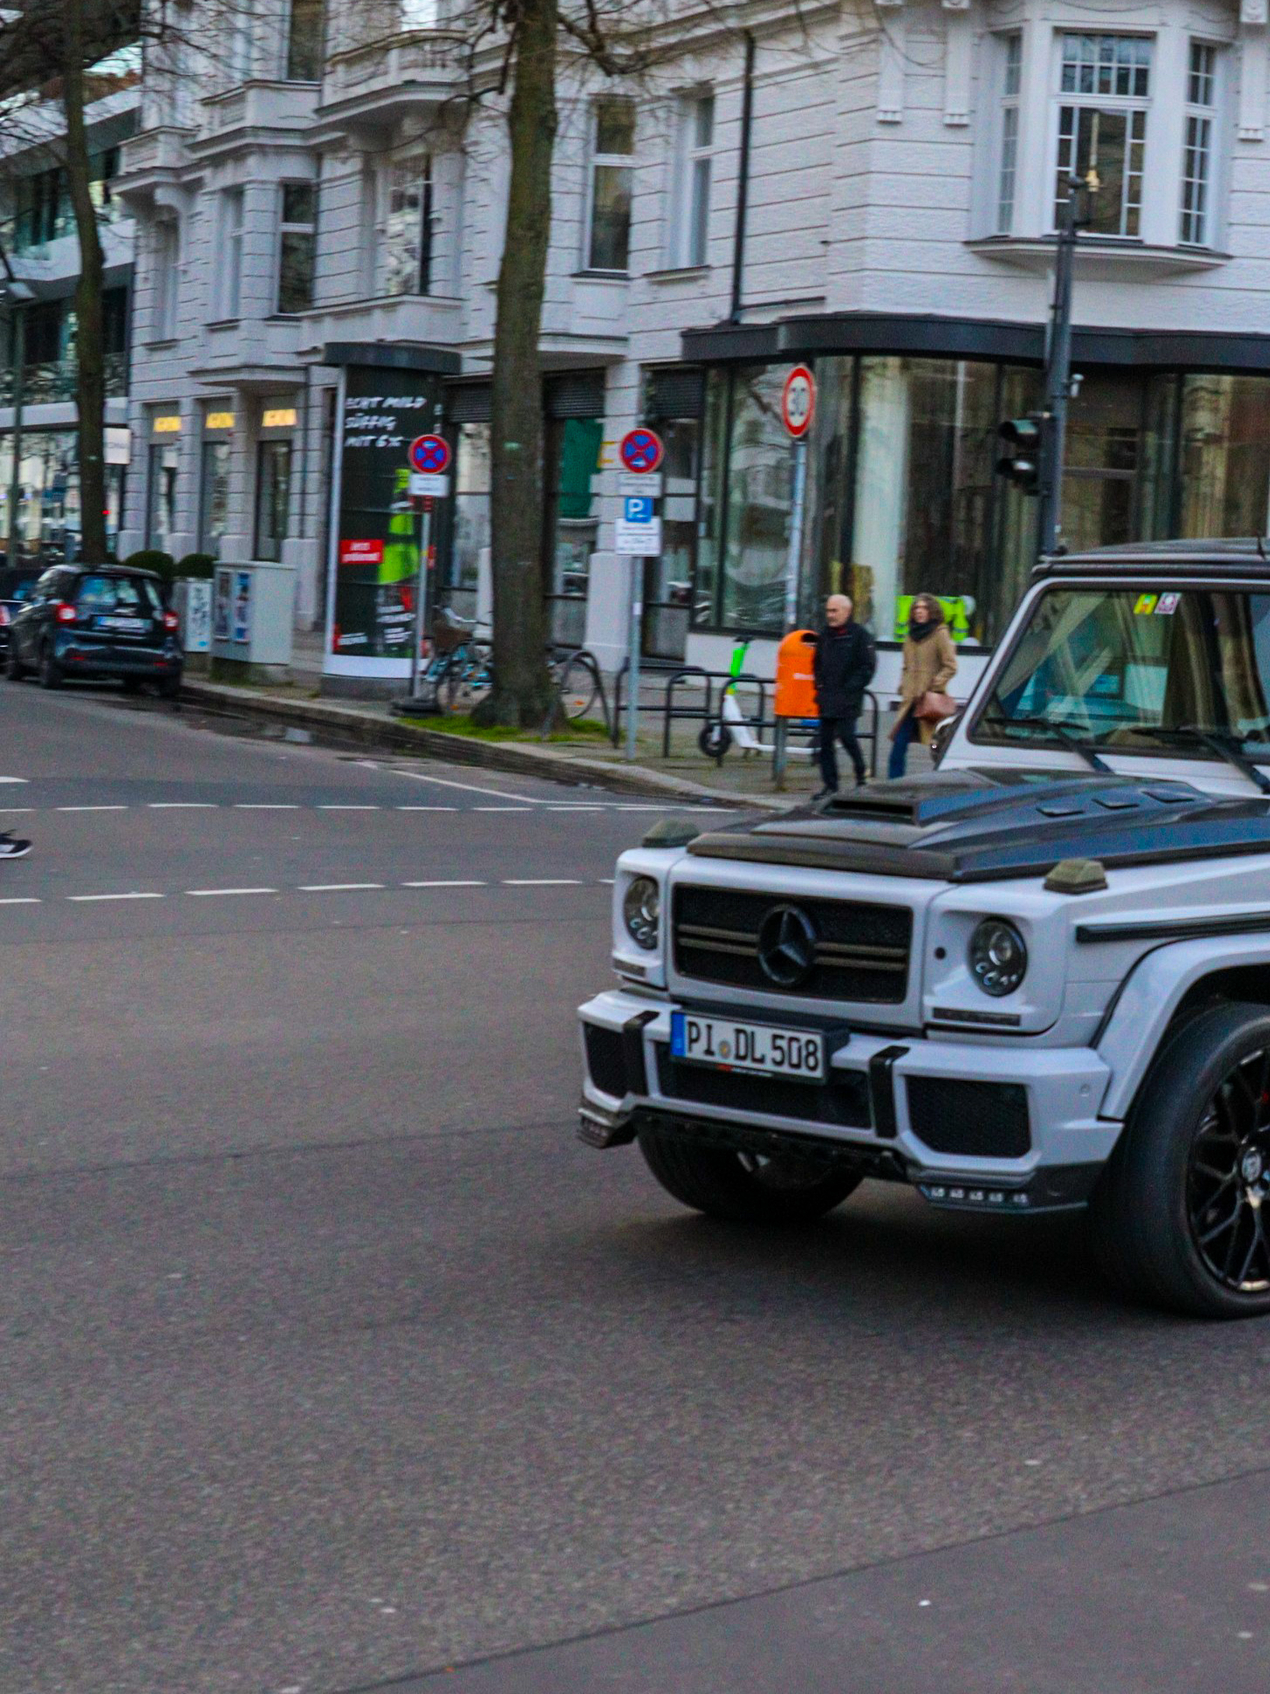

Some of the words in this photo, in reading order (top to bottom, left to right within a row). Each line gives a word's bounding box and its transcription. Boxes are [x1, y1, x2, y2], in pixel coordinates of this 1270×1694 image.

[382, 396, 427, 409] MILD
[344, 434, 377, 448] MIT
[627, 499, 644, 519] P
[687, 1021, 716, 1057] PI
[734, 1028, 765, 1064] DL
[772, 1034, 819, 1072] 508
